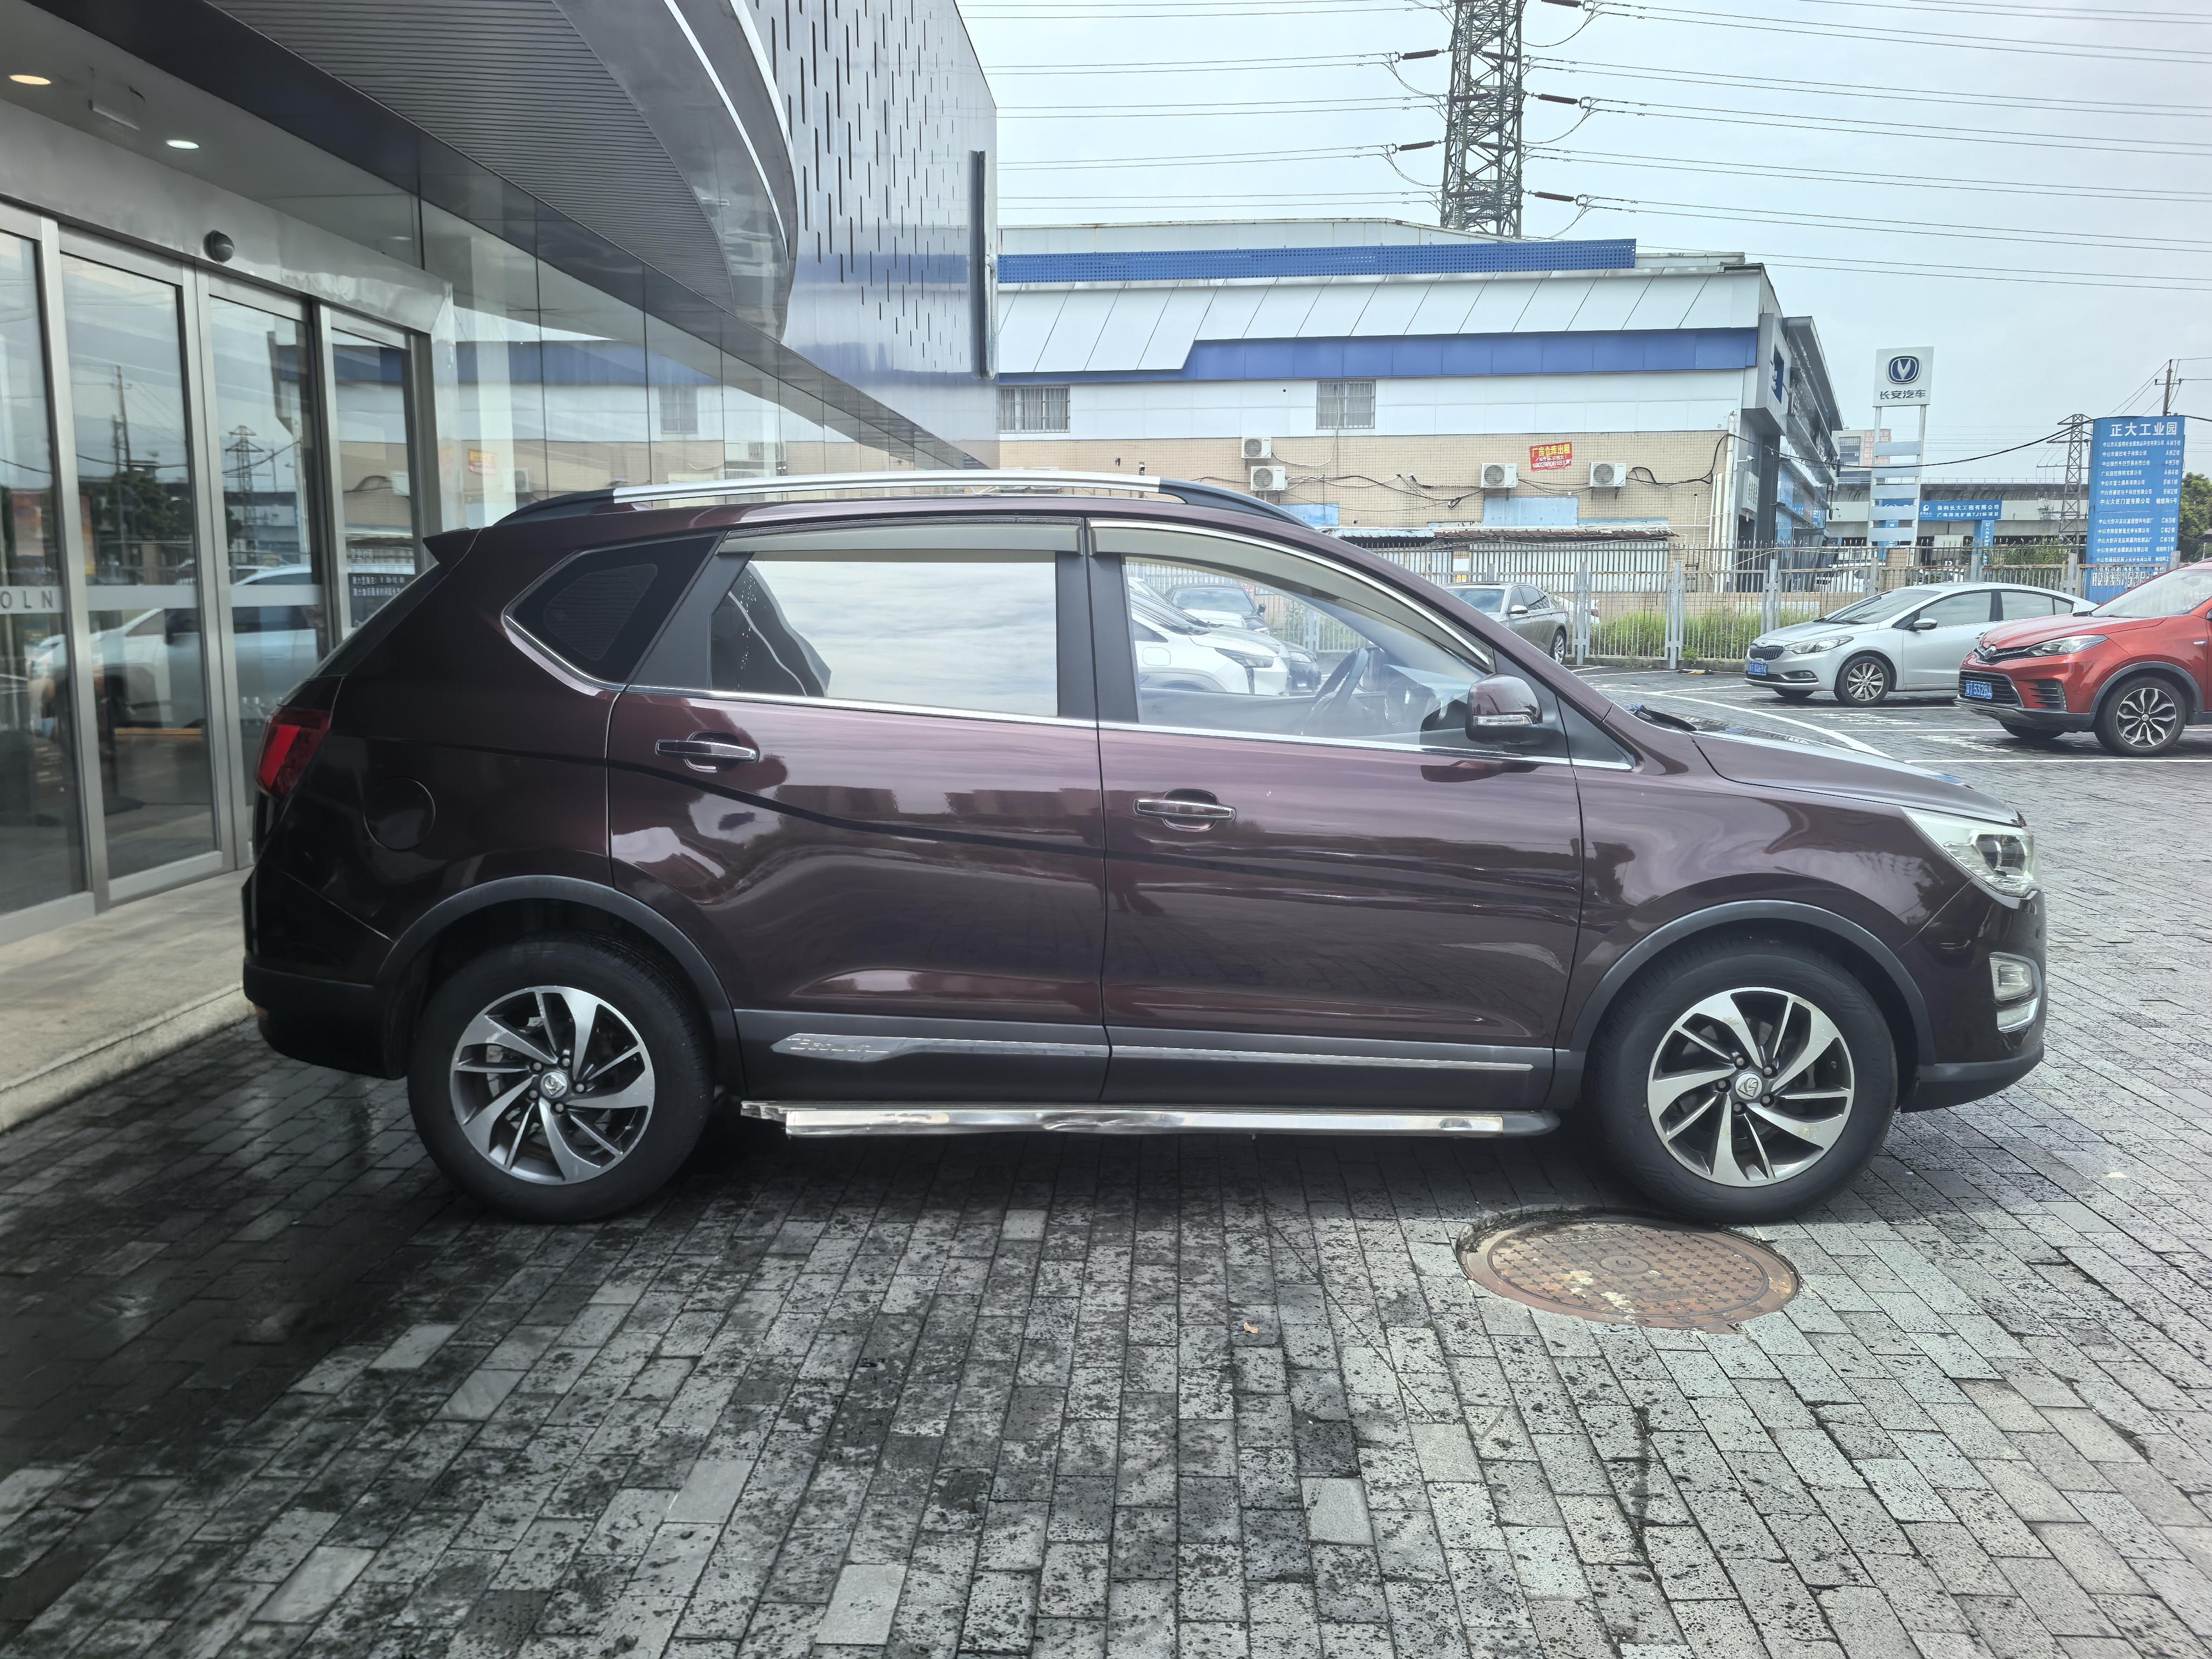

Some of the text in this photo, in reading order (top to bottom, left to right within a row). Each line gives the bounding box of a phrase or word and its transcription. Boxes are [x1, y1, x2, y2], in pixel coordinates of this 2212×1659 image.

[1879, 389, 1926, 400] 长安汽车
[2109, 422, 2178, 437] 正大工业园
[1532, 444, 1570, 457] 厂房仓库出租
